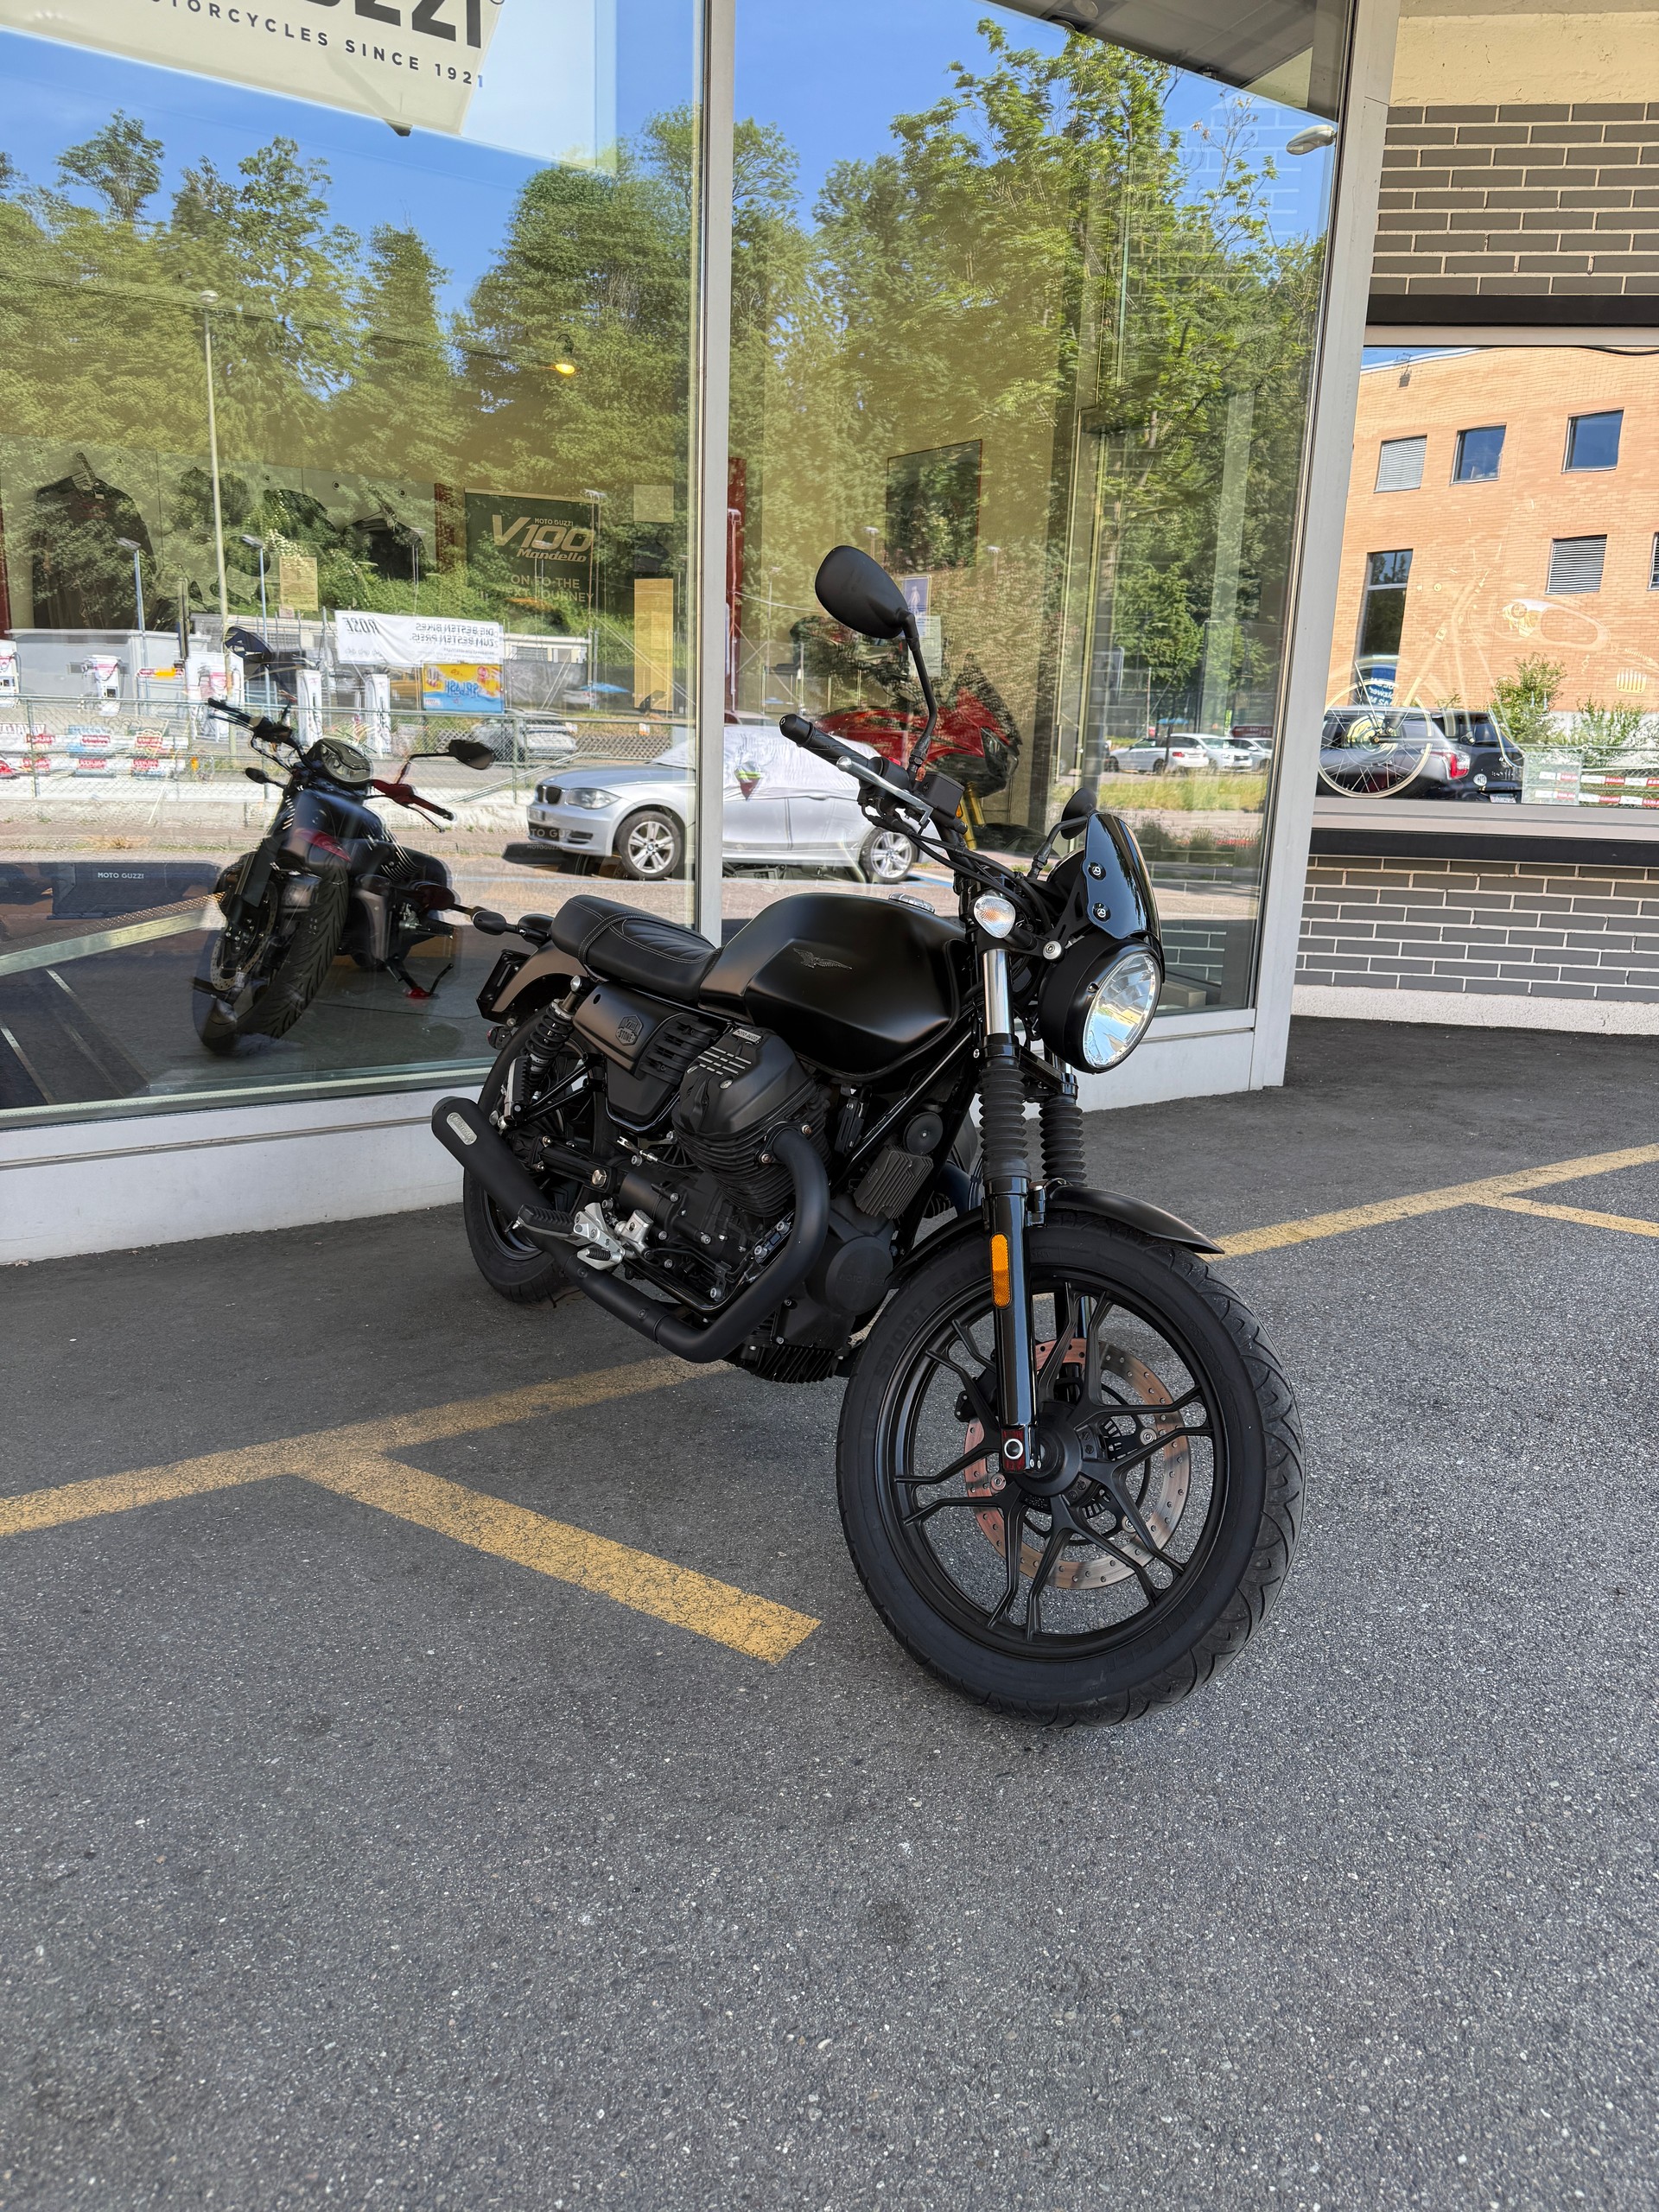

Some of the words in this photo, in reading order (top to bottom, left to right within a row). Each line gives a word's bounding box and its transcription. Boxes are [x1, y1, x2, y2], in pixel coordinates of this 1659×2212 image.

[151, 0, 328, 46] ORCYCLES
[346, 39, 419, 70] SINCE
[435, 63, 483, 87] 1921
[492, 514, 594, 552] V100
[517, 548, 587, 563] Mandello
[510, 574, 530, 586] ON
[534, 575, 552, 588] TO
[556, 576, 580, 589] THE
